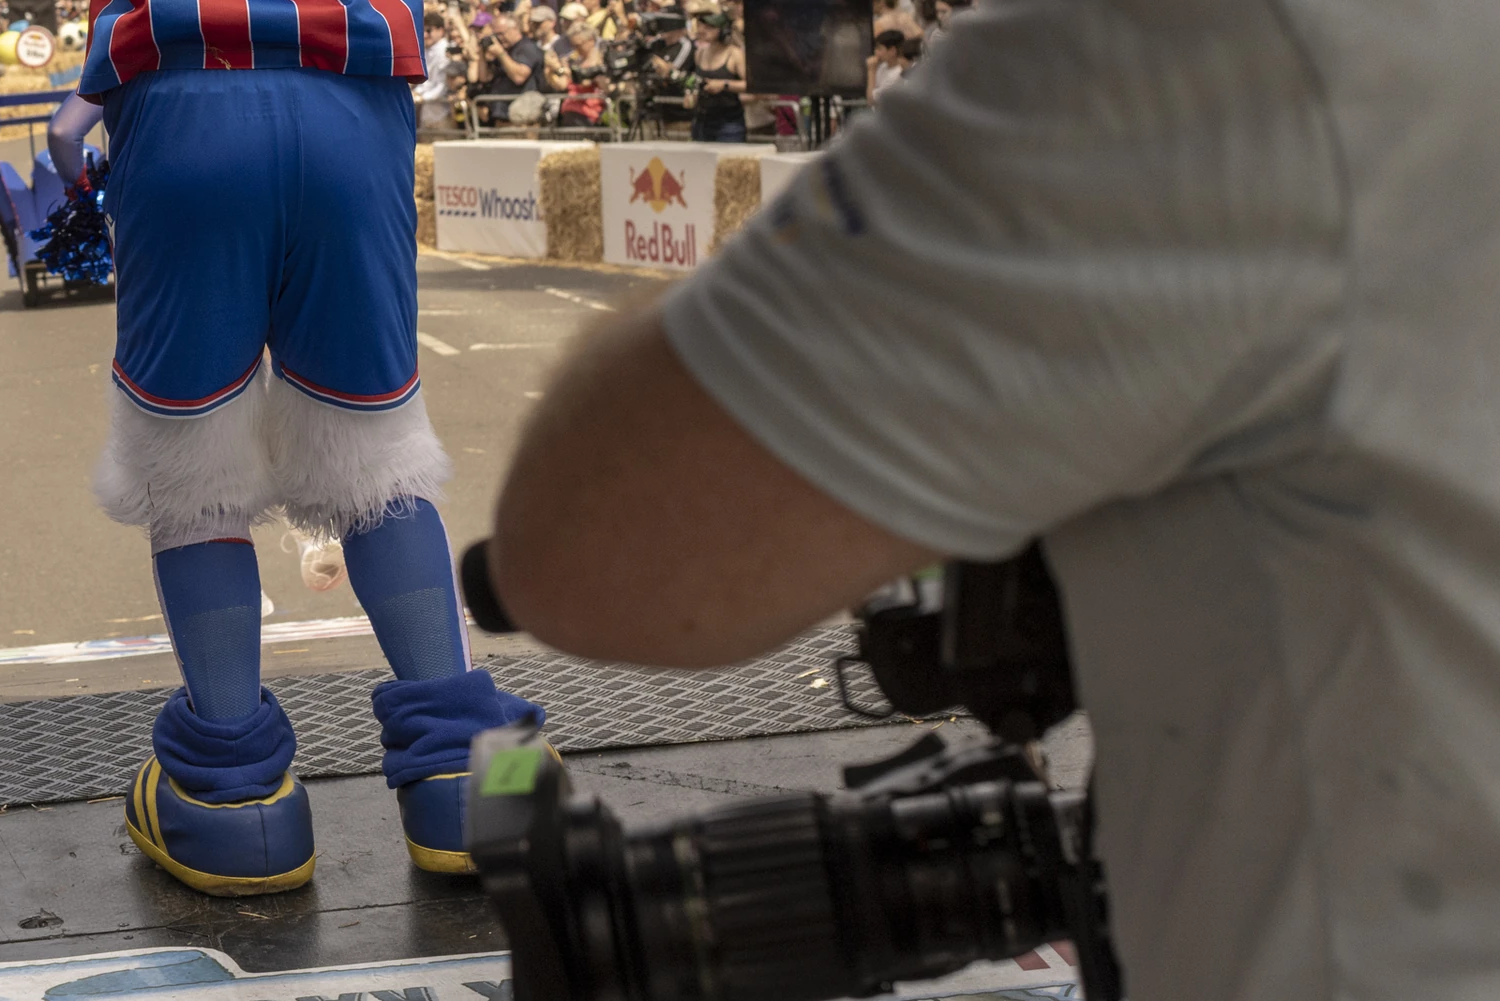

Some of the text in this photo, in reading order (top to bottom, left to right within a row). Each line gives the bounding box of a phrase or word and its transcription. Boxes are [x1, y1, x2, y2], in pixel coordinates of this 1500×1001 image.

[438, 185, 536, 221] TESCO Whoosh
[625, 220, 696, 267] Red Bull
